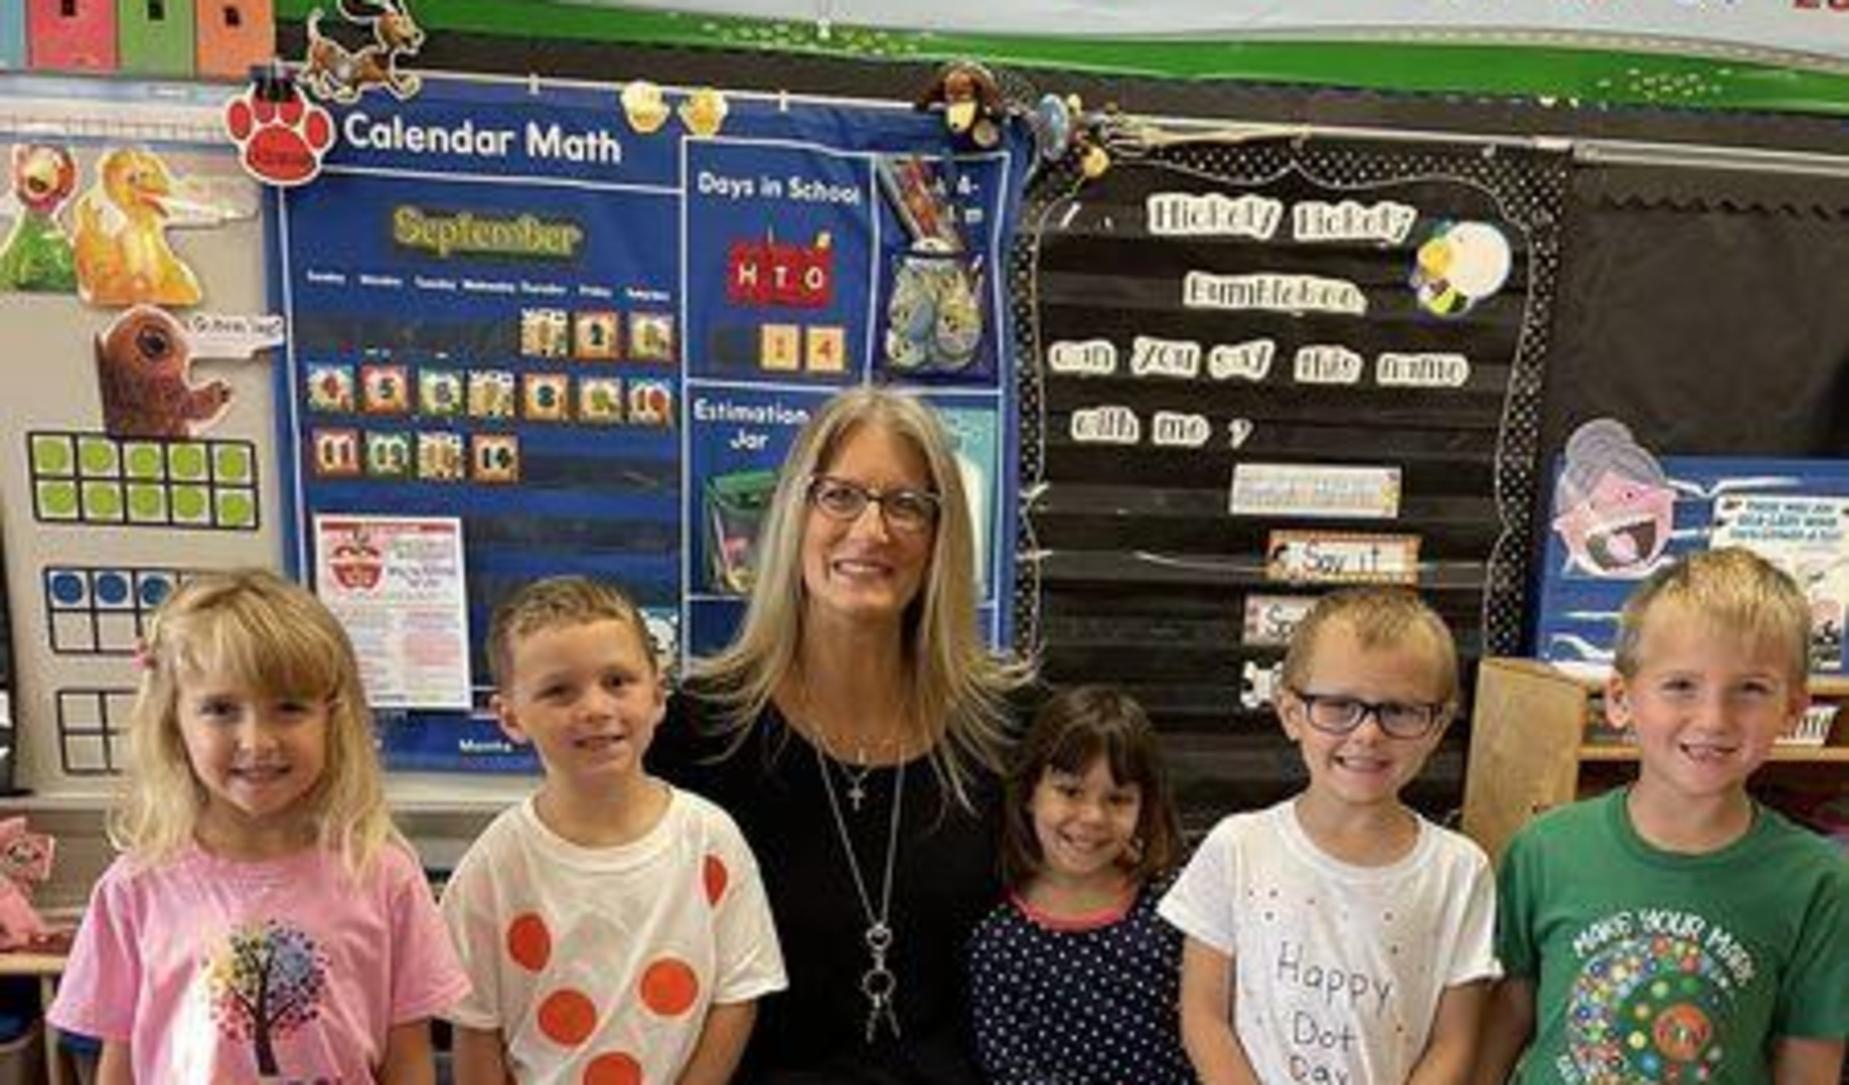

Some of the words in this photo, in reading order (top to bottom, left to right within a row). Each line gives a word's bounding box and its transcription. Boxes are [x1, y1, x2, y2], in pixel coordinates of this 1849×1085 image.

[345, 114, 515, 157] Calendar
[526, 121, 622, 163] Math
[698, 172, 755, 197] Days
[760, 175, 782, 197] in
[788, 177, 860, 203] School
[394, 205, 583, 255] September
[738, 265, 757, 286] H
[773, 267, 787, 287] T
[818, 339, 832, 361] 4
[694, 399, 811, 425] Estimation
[730, 430, 770, 451] Jar
[1360, 545, 1380, 573] it
[1639, 908, 1706, 937] YOUR
[1277, 940, 1392, 1018] Happy
[1294, 1011, 1357, 1052] Dot
[1290, 1054, 1349, 1085] Day
